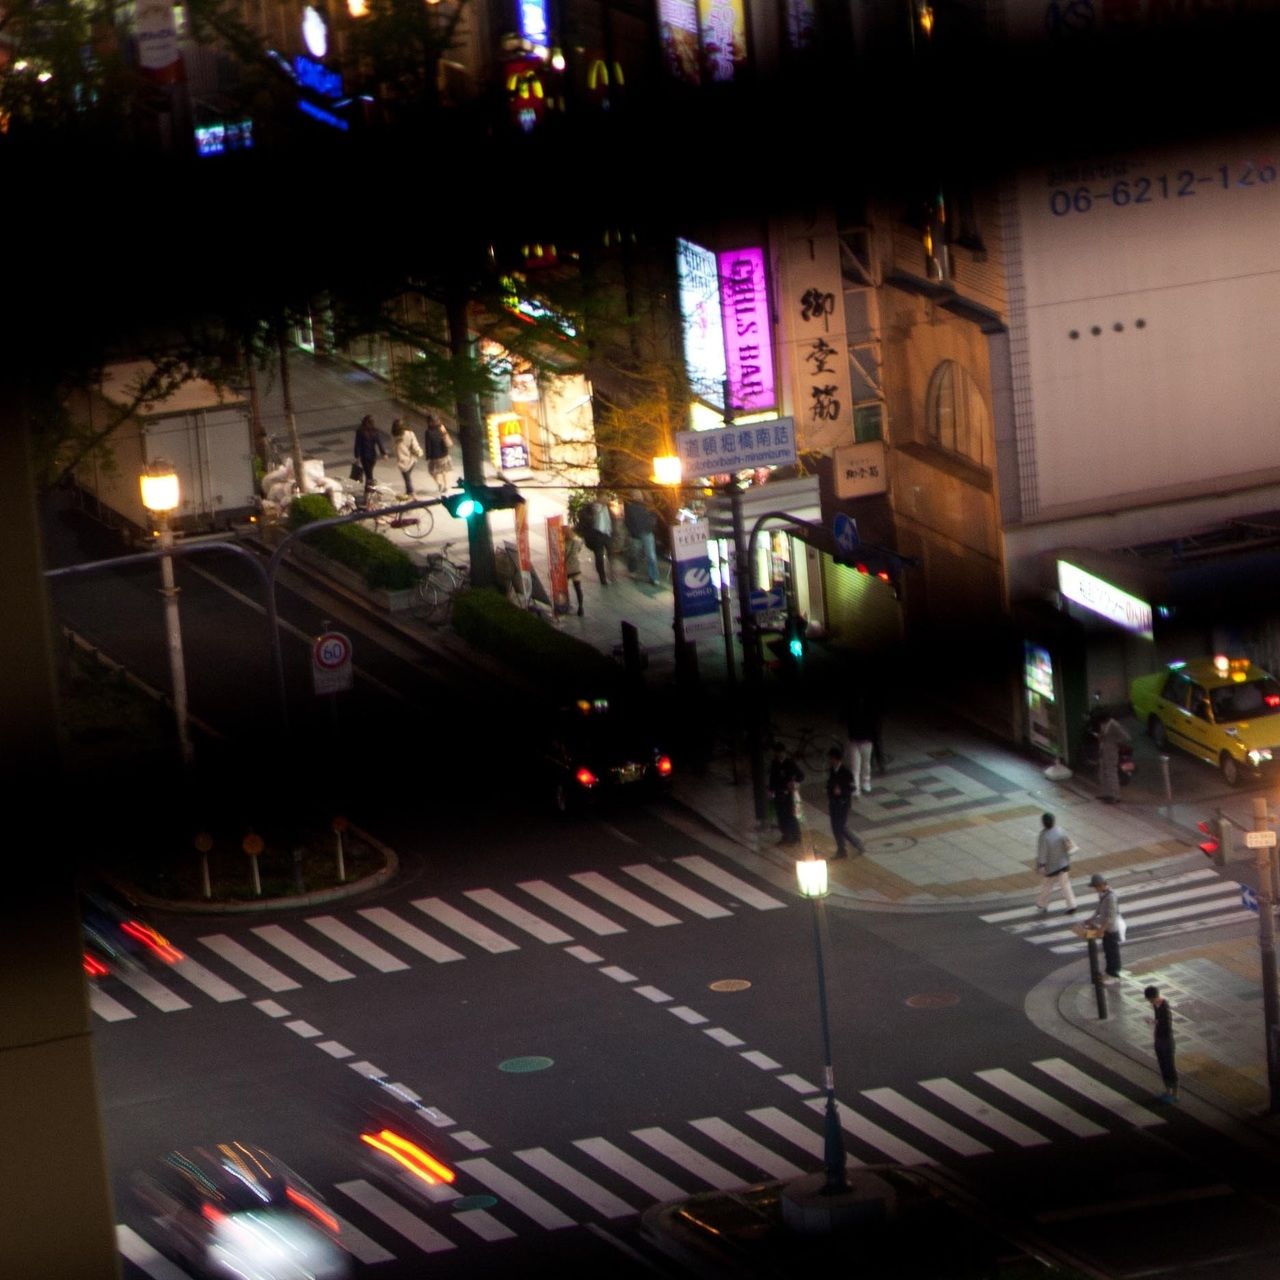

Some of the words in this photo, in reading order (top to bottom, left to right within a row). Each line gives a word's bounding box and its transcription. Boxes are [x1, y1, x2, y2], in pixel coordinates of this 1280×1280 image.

[730, 258, 760, 338] GIRLS
[738, 345, 763, 401] BAR
[686, 425, 789, 459] 道頓堀橋南詰
